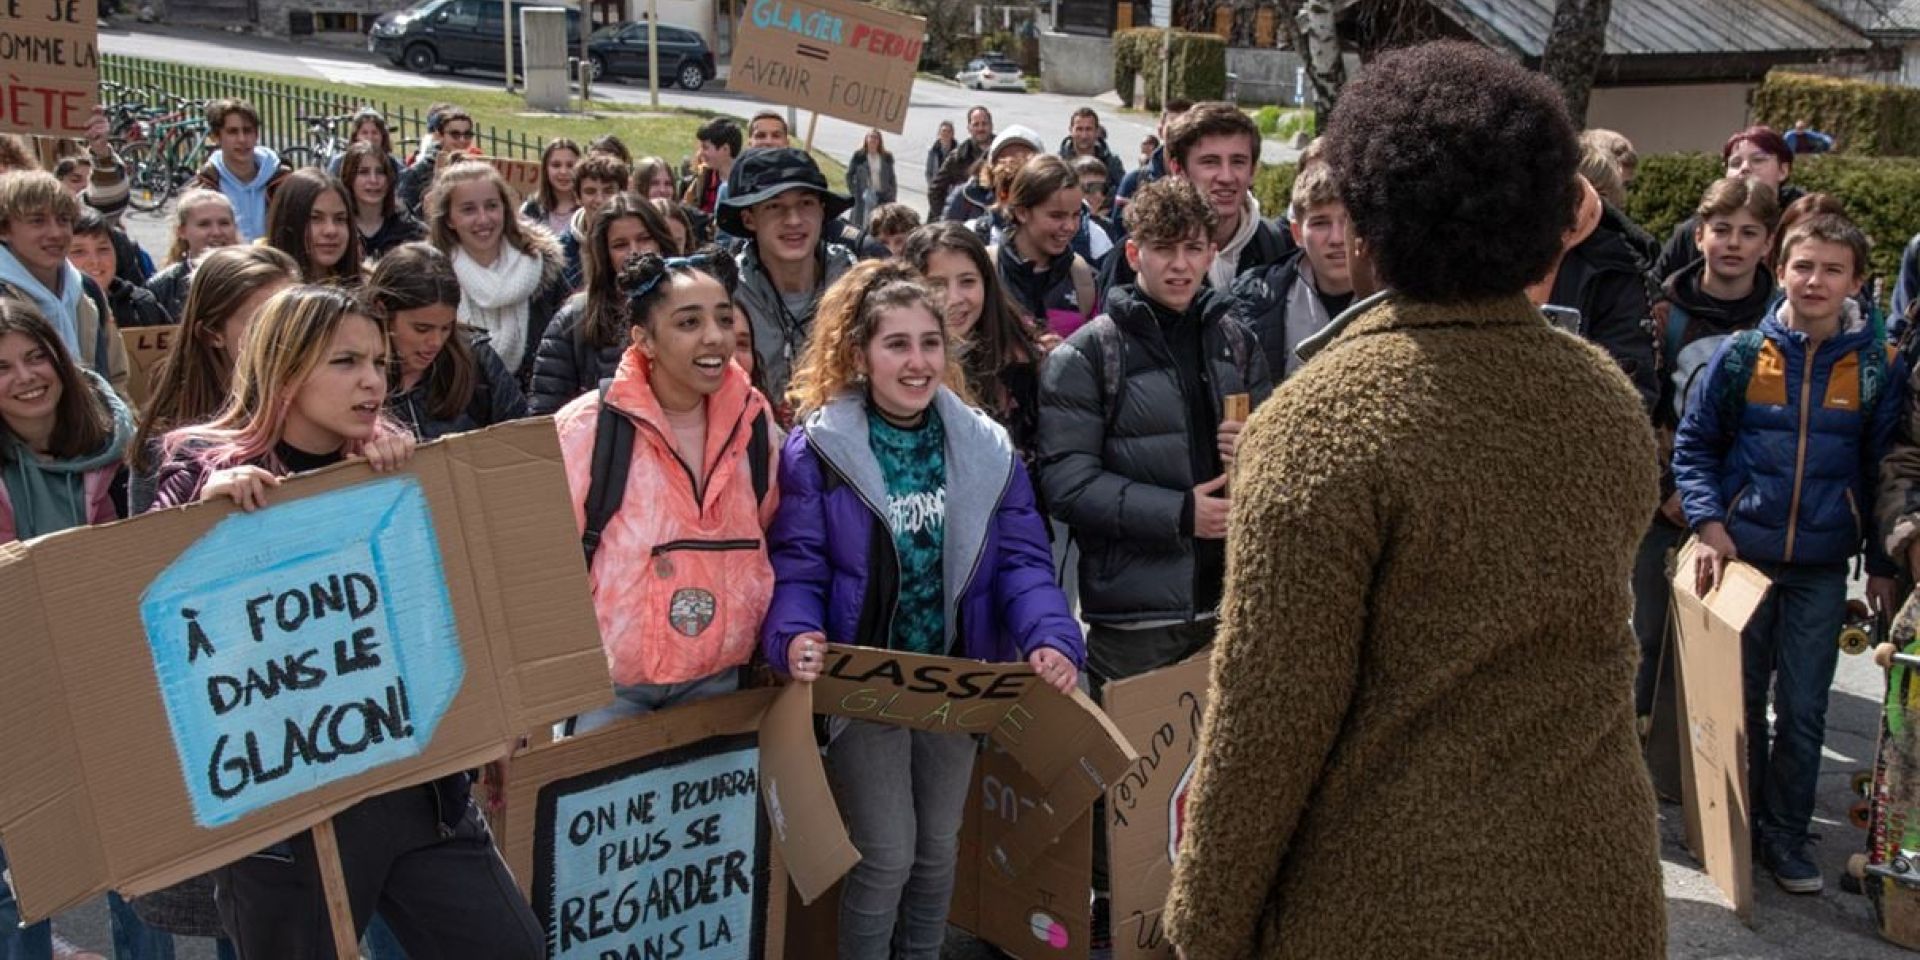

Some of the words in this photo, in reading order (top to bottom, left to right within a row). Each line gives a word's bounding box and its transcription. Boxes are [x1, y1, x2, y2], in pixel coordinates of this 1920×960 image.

[46, 0, 79, 23] JE
[73, 40, 97, 69] LA
[849, 24, 922, 62] PERDU
[0, 73, 91, 130] ÈTE
[738, 55, 811, 96] AVENIR
[828, 75, 902, 123] FOUTU
[181, 607, 216, 663] À
[246, 573, 378, 642] FOND
[207, 649, 326, 716] DANS
[333, 627, 382, 676] LE
[208, 676, 414, 800] GLACON!
[841, 688, 1034, 745] GLACE
[568, 801, 616, 847] ON
[626, 790, 656, 826] NE
[598, 829, 671, 875] PLUS
[682, 814, 721, 849] SE
[560, 850, 750, 952] REGARDER
[699, 914, 732, 950] LA
